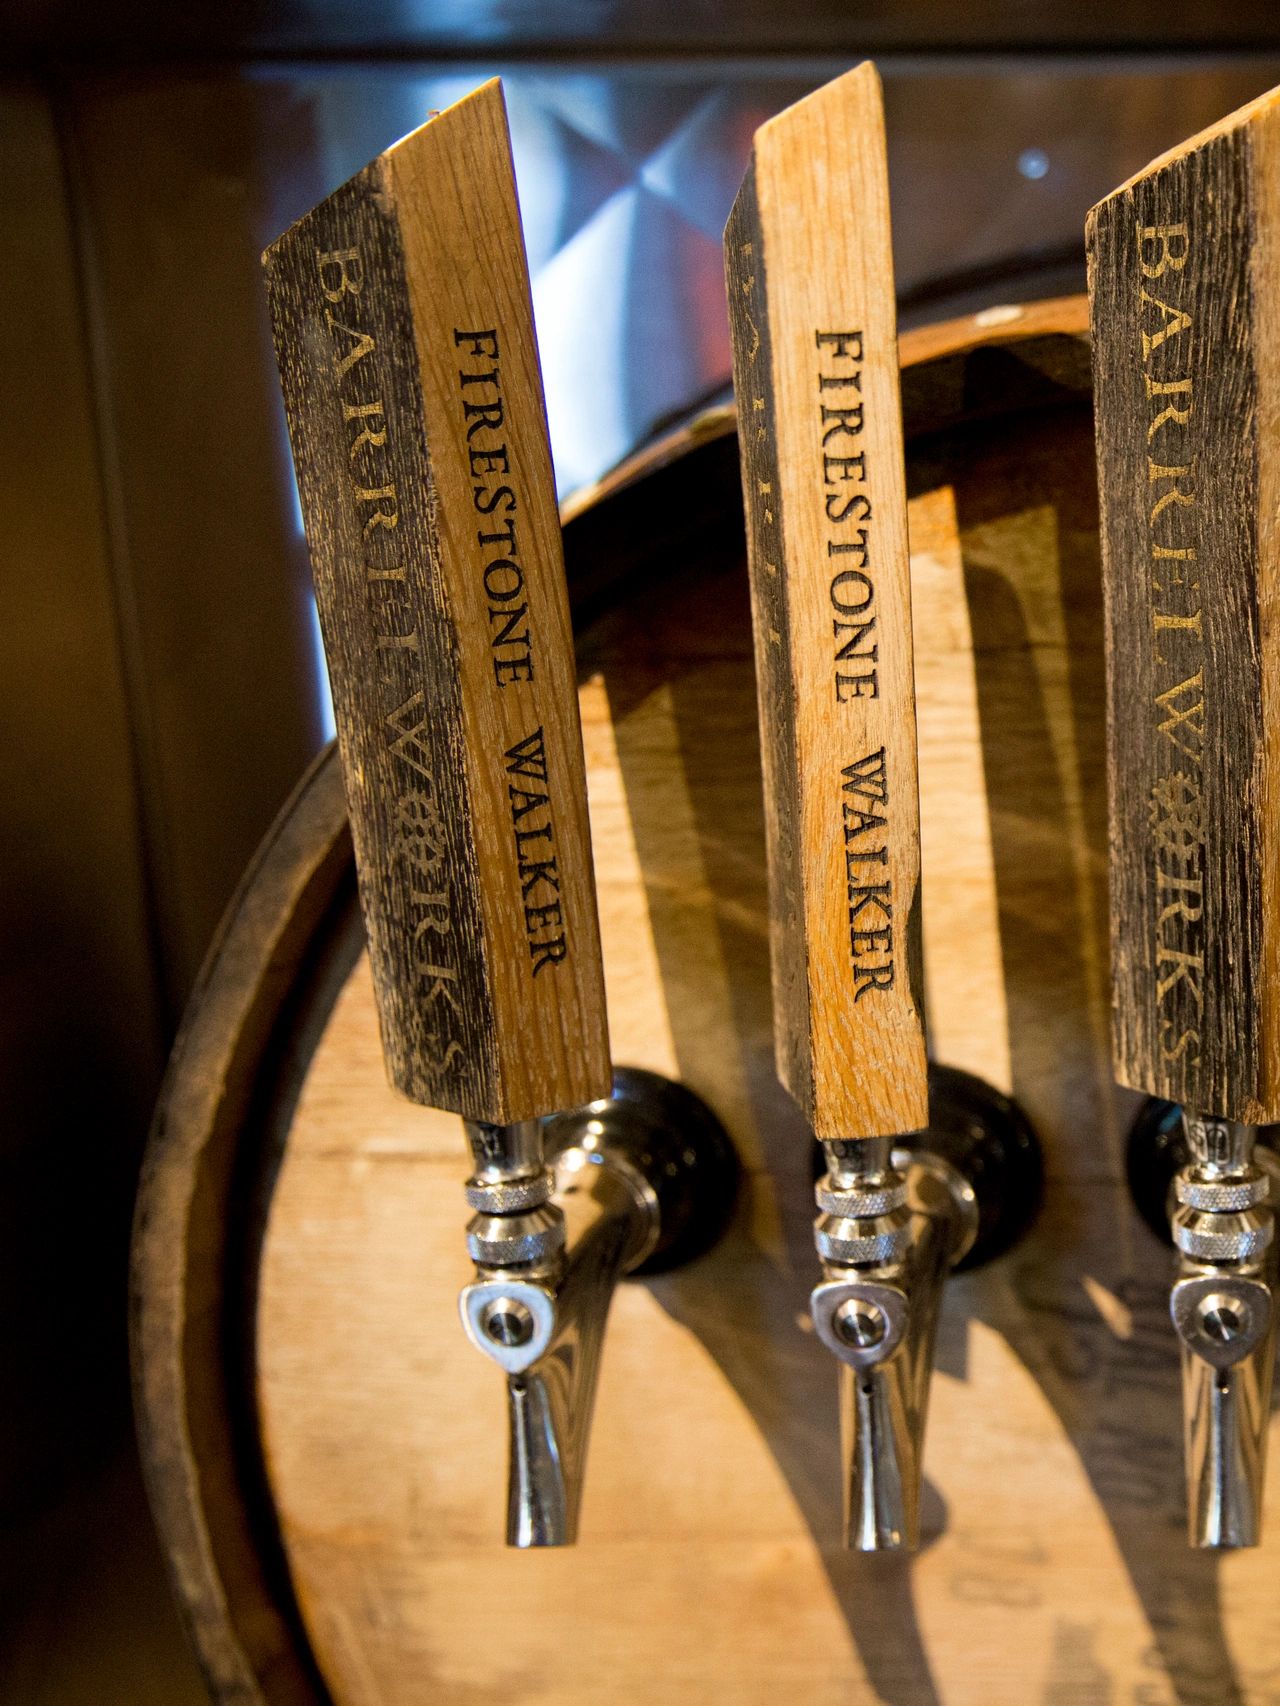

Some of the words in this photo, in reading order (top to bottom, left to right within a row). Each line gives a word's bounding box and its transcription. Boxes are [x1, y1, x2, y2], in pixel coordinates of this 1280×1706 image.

[453, 328, 535, 687] FIRESTONE
[505, 726, 568, 979] WALKER
[814, 329, 879, 704] FIRESTONE
[842, 746, 895, 1003] WALKER
